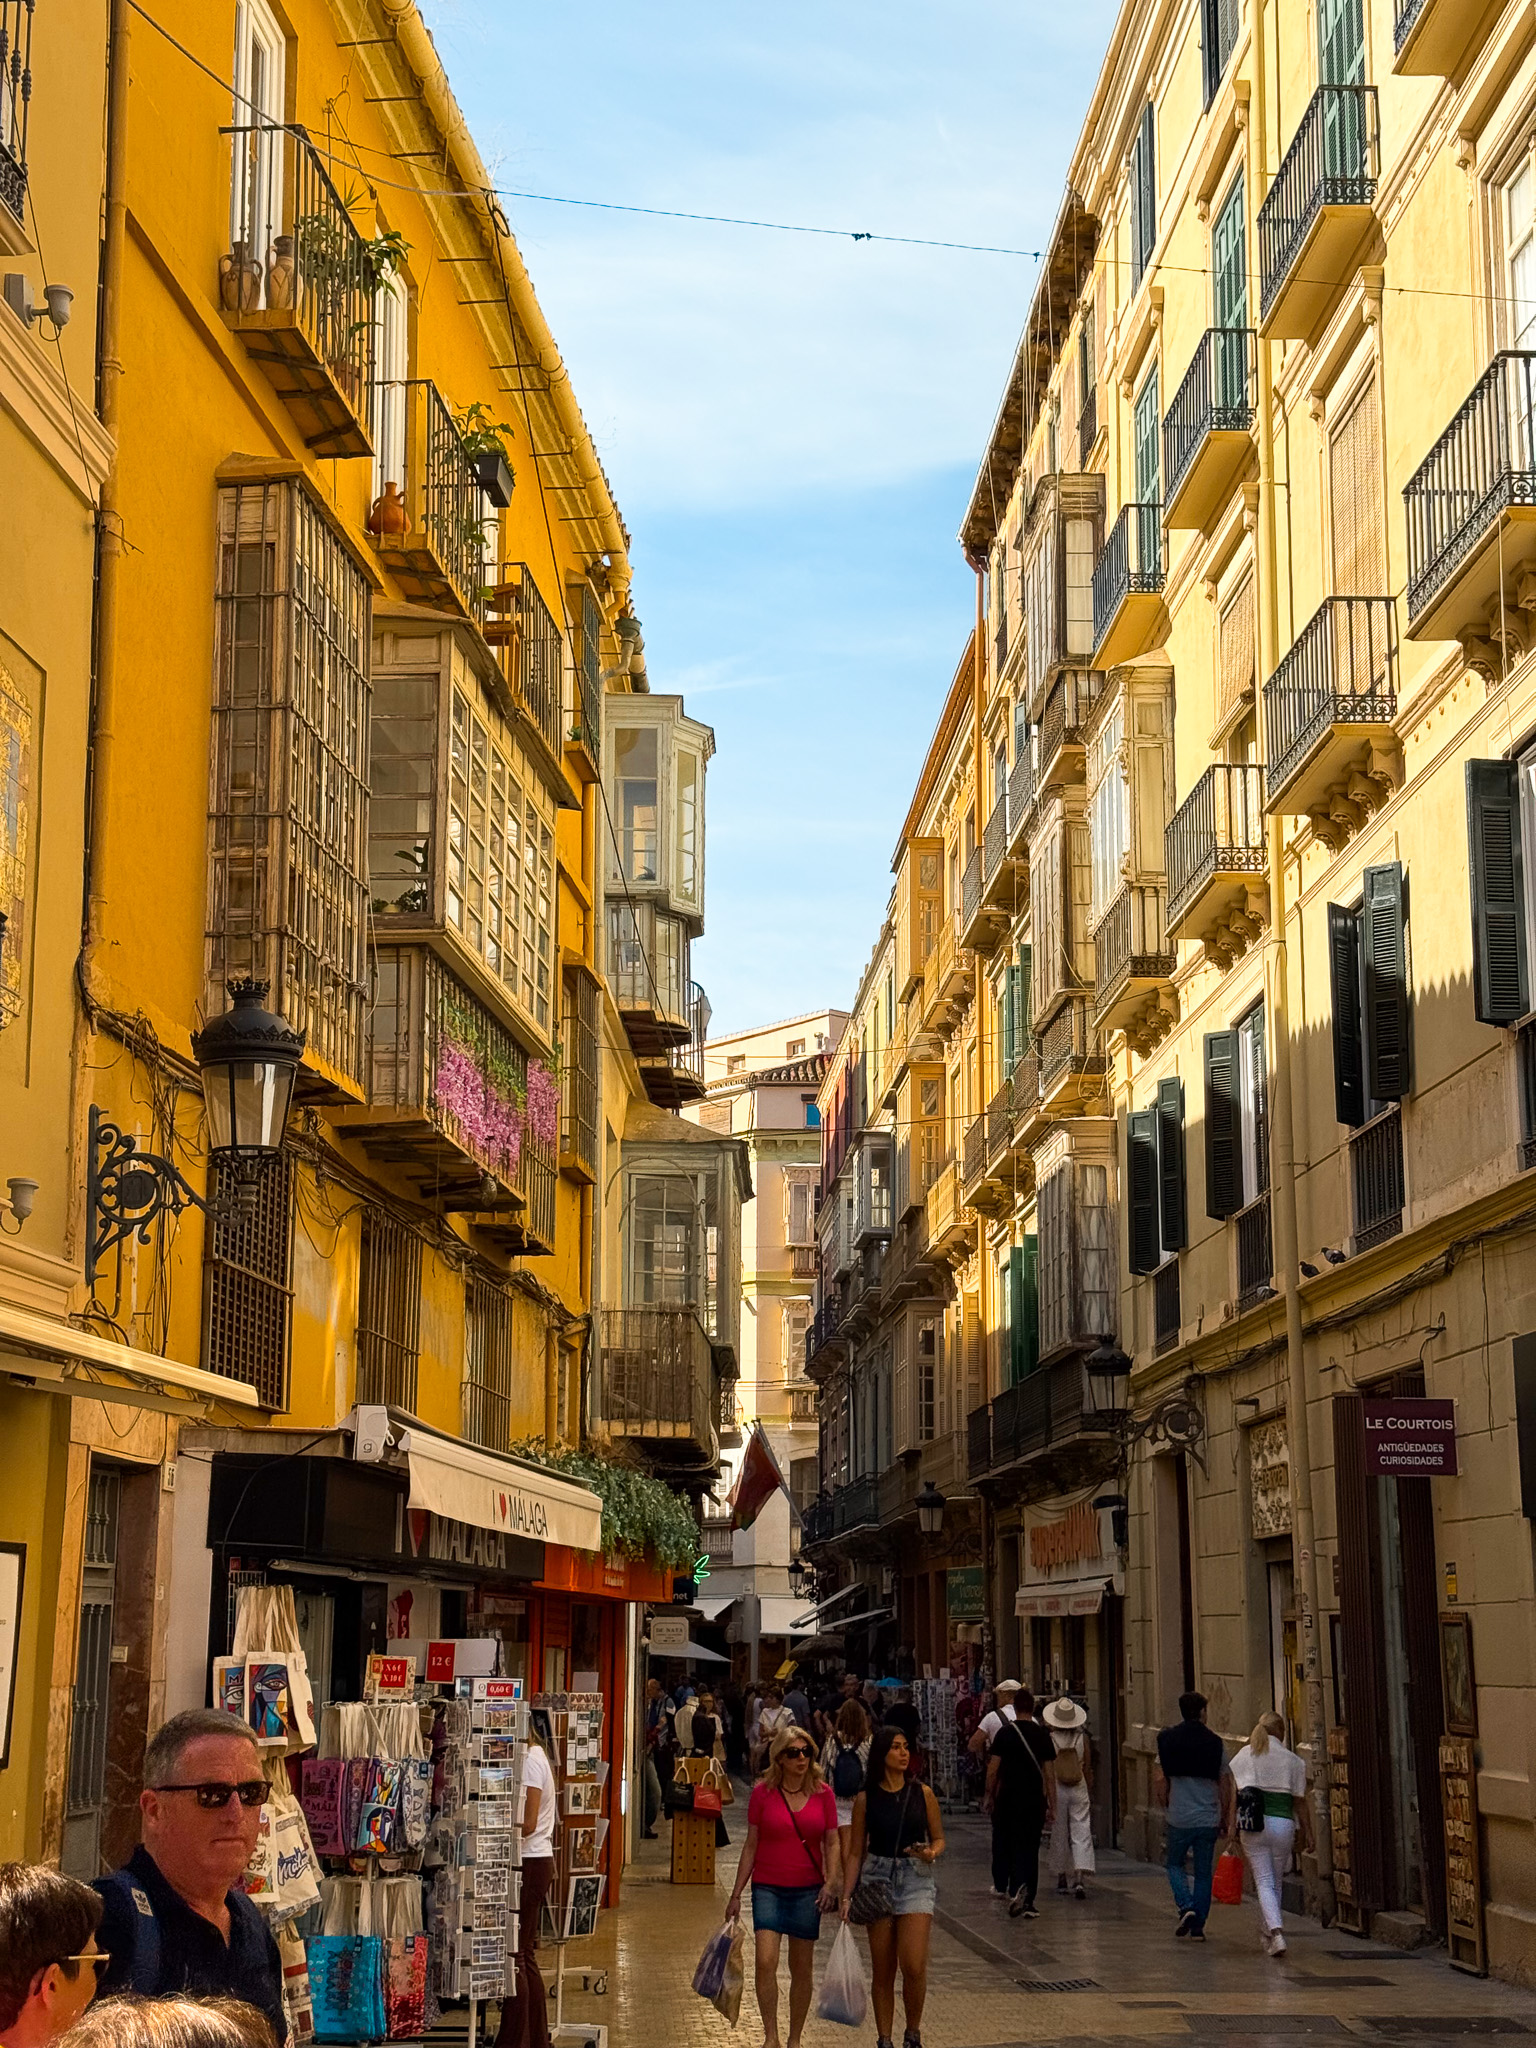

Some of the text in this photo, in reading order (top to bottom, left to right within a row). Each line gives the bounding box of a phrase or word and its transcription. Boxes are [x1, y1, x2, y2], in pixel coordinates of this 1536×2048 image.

[1366, 1417, 1453, 1430] LE COURTOIS
[1377, 1441, 1444, 1453] ANTIGÜEDADES
[1379, 1455, 1444, 1466] CURIOSIDADES
[508, 1489, 549, 1538] MÁLAGA
[431, 1656, 442, 1666] 12
[489, 1685, 504, 1694] 0,60
